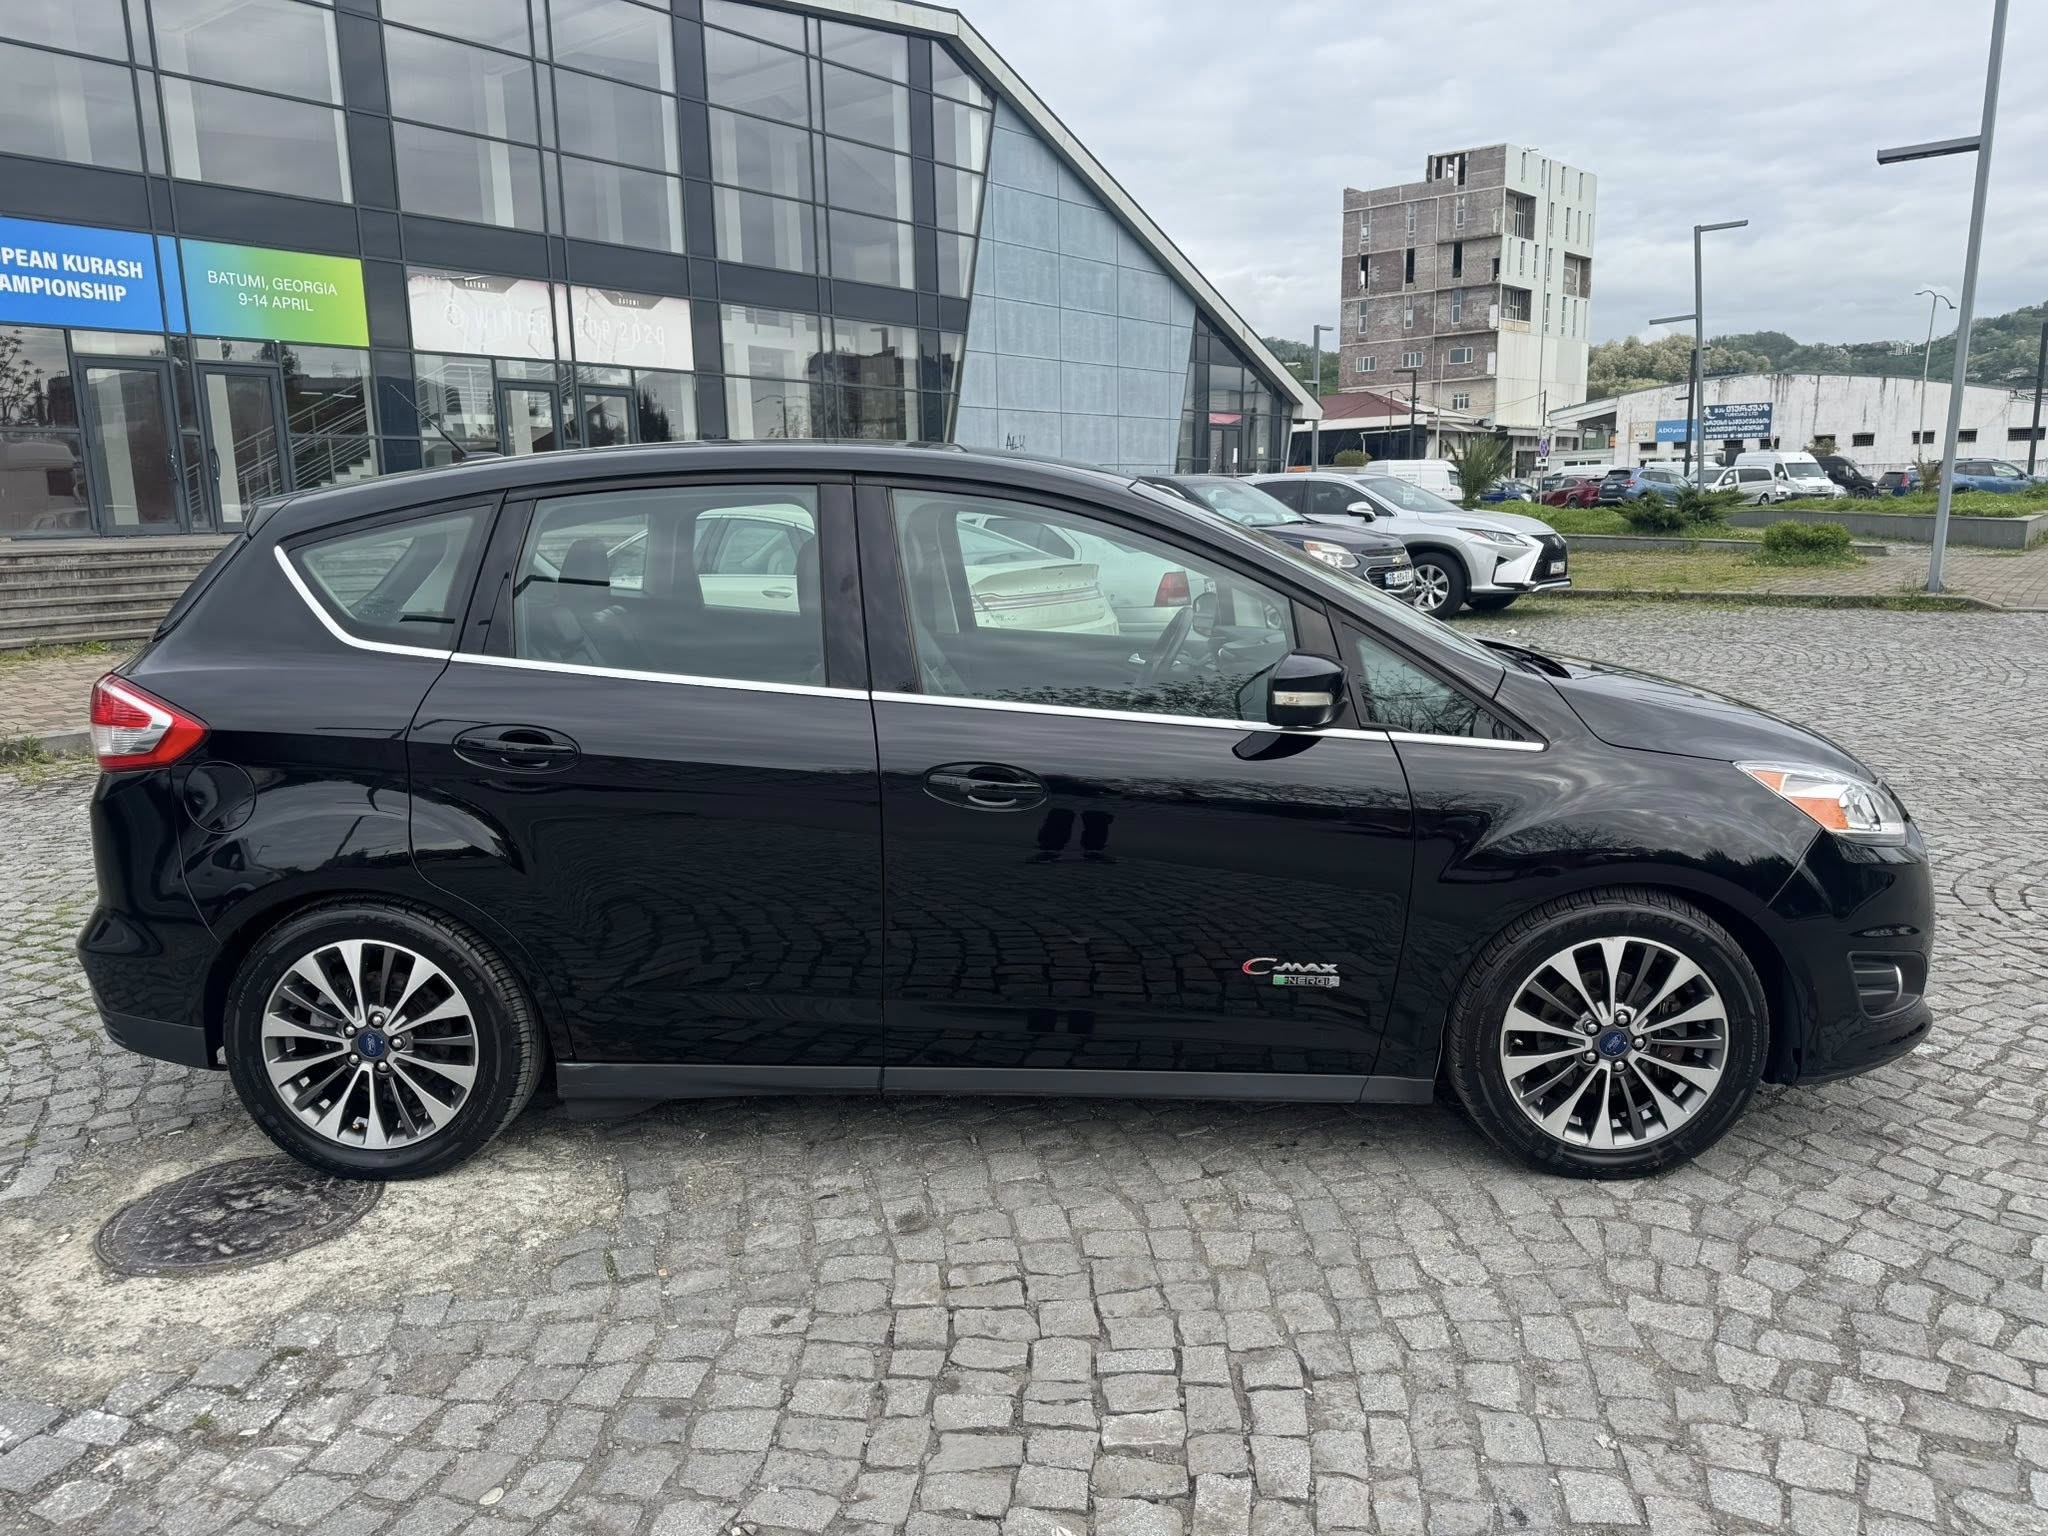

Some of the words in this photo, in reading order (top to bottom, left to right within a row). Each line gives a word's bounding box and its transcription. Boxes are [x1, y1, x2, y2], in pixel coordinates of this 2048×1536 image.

[0, 246, 58, 271] PEAN
[62, 253, 143, 279] KURASH
[0, 273, 127, 302] AMPIONSHIP
[207, 270, 269, 291] BATUMI,
[272, 277, 338, 296] GEORGIA
[238, 292, 268, 308] 9-14
[272, 296, 314, 312] APRIL
